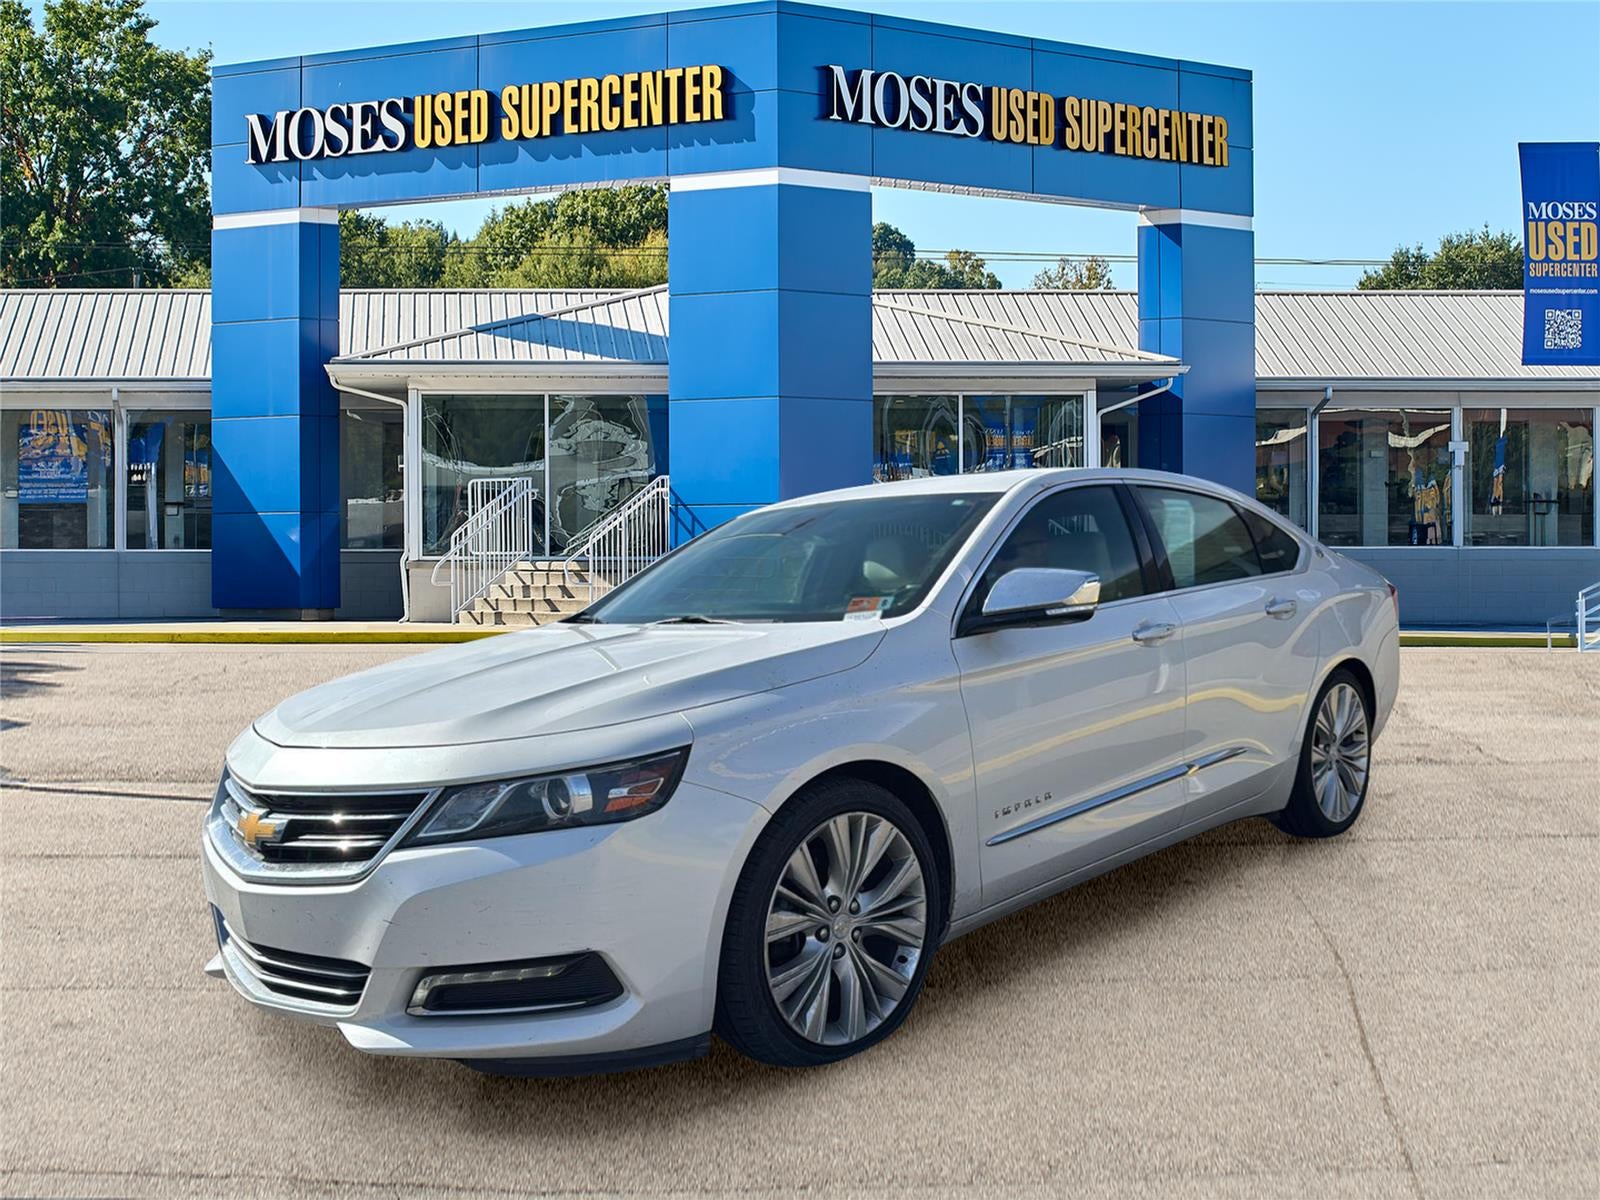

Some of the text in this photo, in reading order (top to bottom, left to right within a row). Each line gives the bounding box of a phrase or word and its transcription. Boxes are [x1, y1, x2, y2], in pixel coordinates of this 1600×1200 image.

[244, 64, 725, 165] MOSES USED SUPERCENTER
[829, 64, 1229, 167] MOSES USED SUPERCENTER
[1528, 201, 1597, 220] MOSES
[1528, 221, 1598, 261] USED
[1529, 263, 1598, 278] SUPERCENTER
[994, 791, 1052, 819] IMPALA
